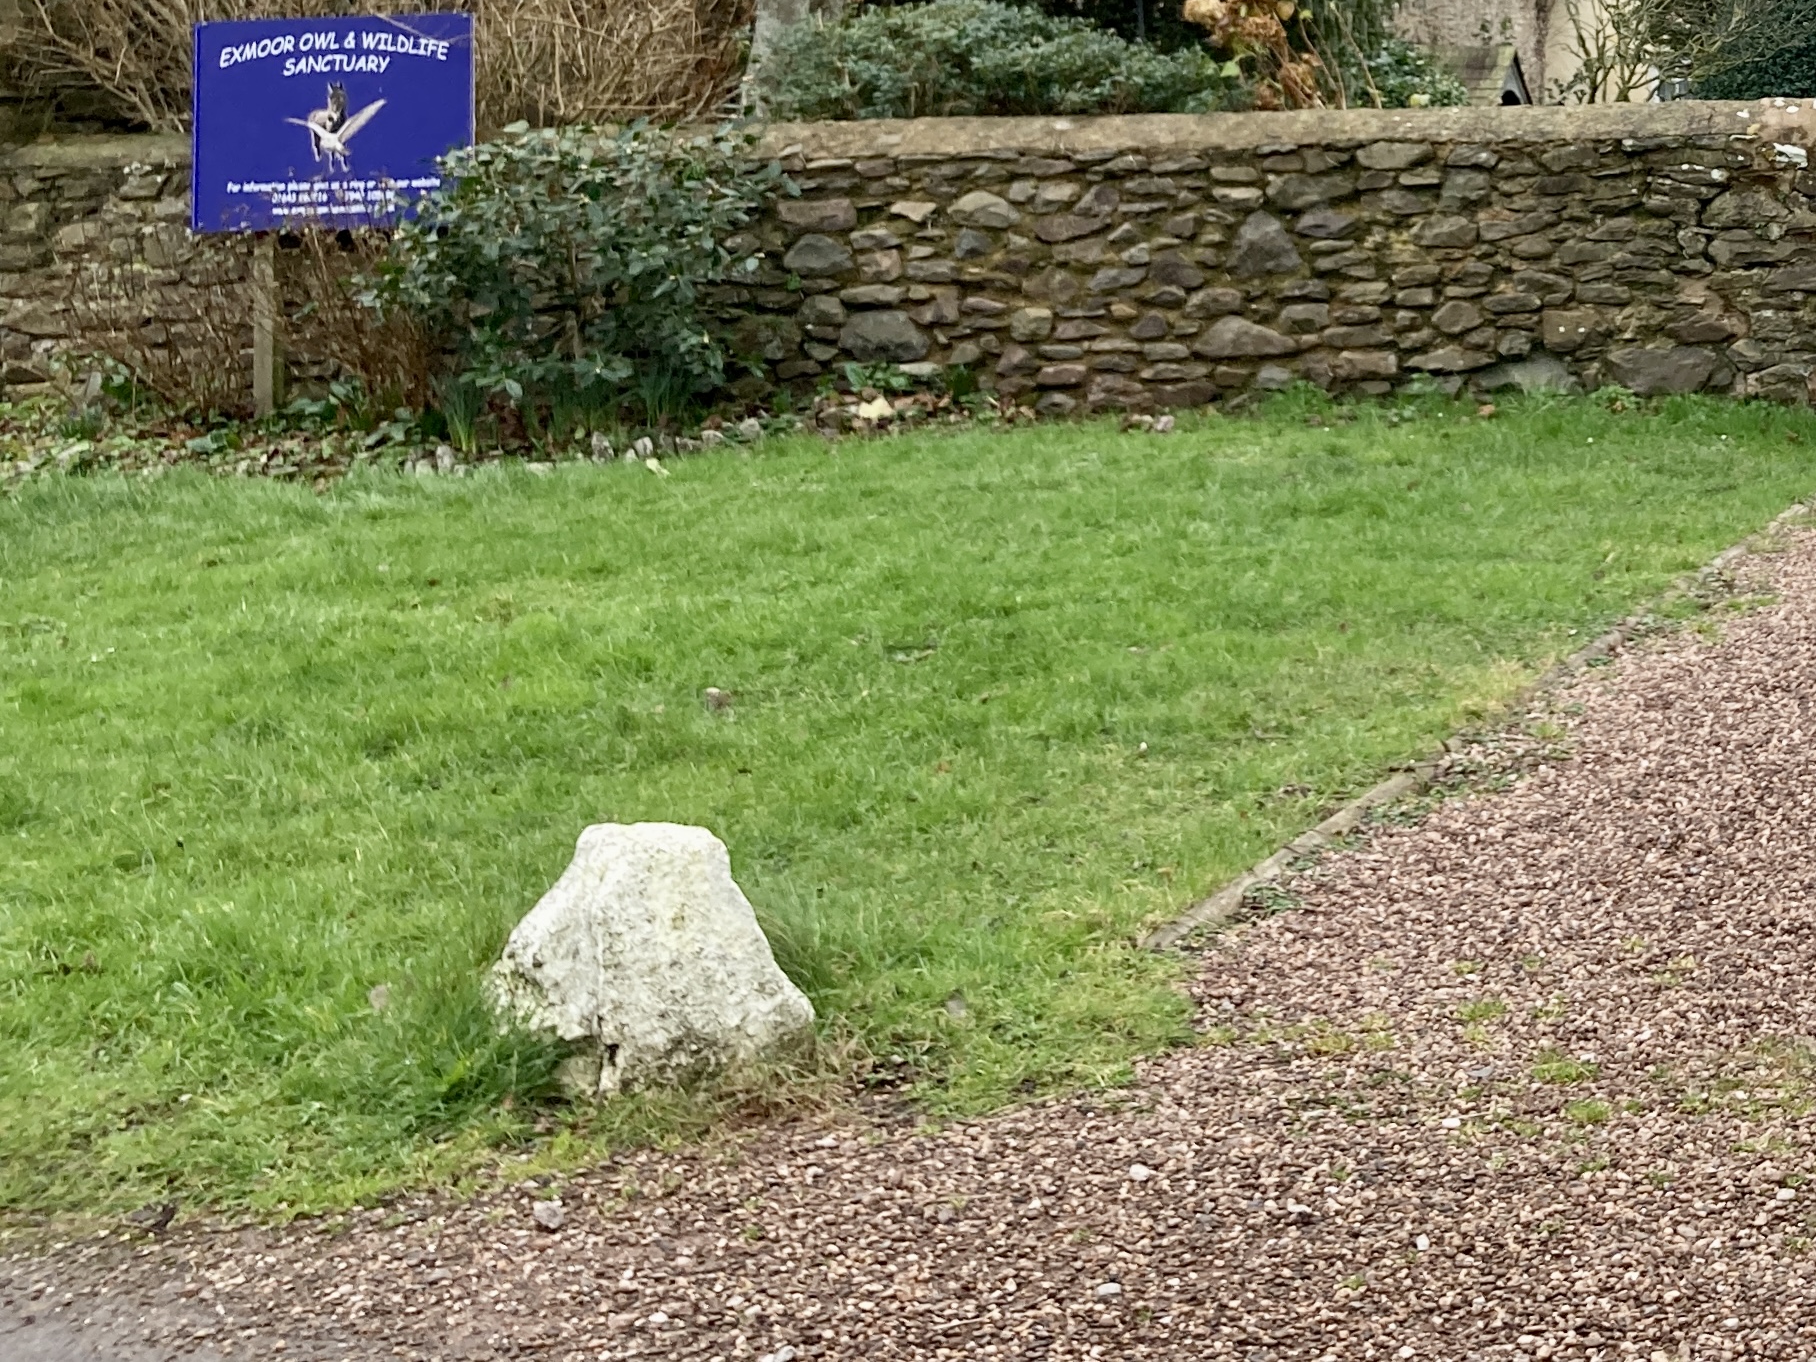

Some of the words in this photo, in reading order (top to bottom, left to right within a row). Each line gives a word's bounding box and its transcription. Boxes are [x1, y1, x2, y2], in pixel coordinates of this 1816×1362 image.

[219, 36, 295, 69] EXMOOR
[299, 31, 339, 53] OWL
[343, 31, 356, 49] &
[362, 32, 450, 61] WILDLIFE
[283, 54, 390, 76] SANCTUARY
